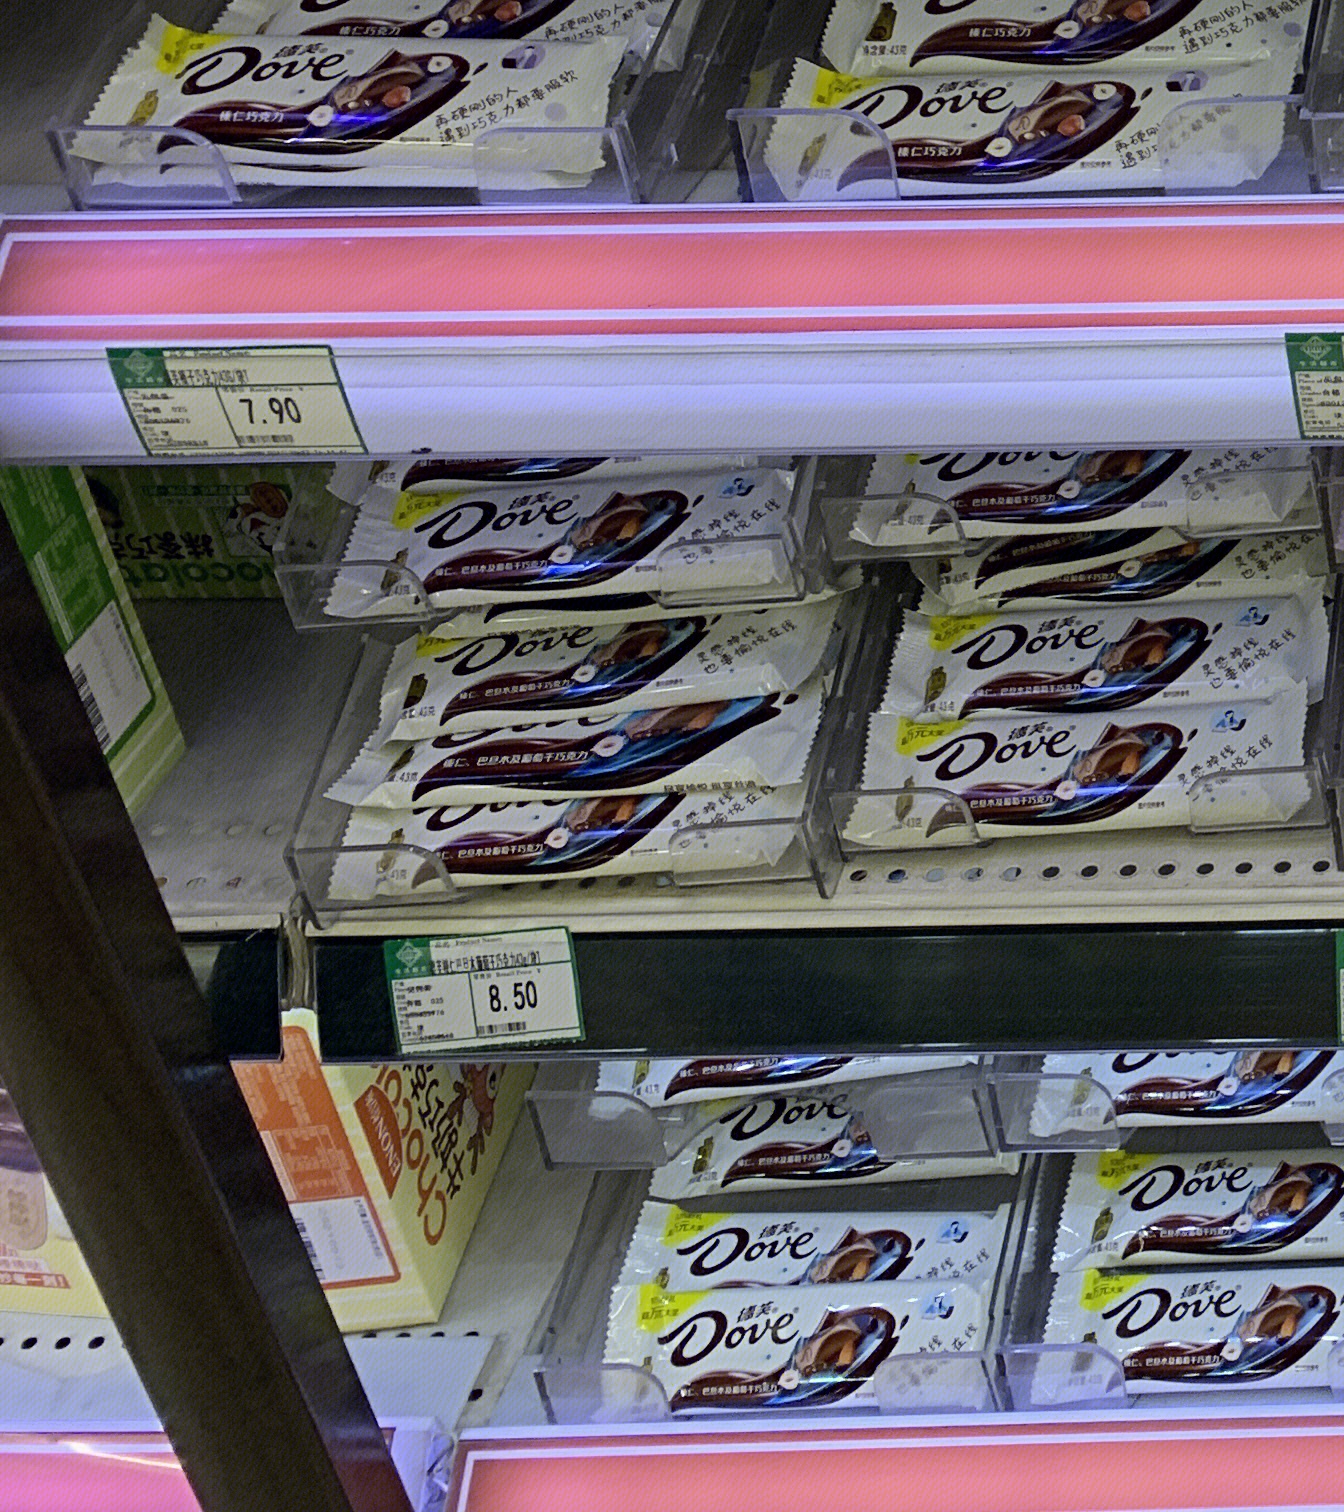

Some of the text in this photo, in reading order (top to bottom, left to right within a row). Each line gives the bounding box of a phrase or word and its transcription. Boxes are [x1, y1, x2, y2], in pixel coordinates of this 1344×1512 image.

[177, 47, 348, 95] Dove
[239, 397, 302, 424] 7.90
[952, 622, 1106, 670] Dove
[916, 730, 1077, 781] Dove
[489, 980, 538, 1012] 8.50
[1118, 1164, 1253, 1211] Dove
[677, 1227, 819, 1276] Dove
[1102, 1287, 1241, 1338] Dove
[658, 1310, 800, 1367] Dove
